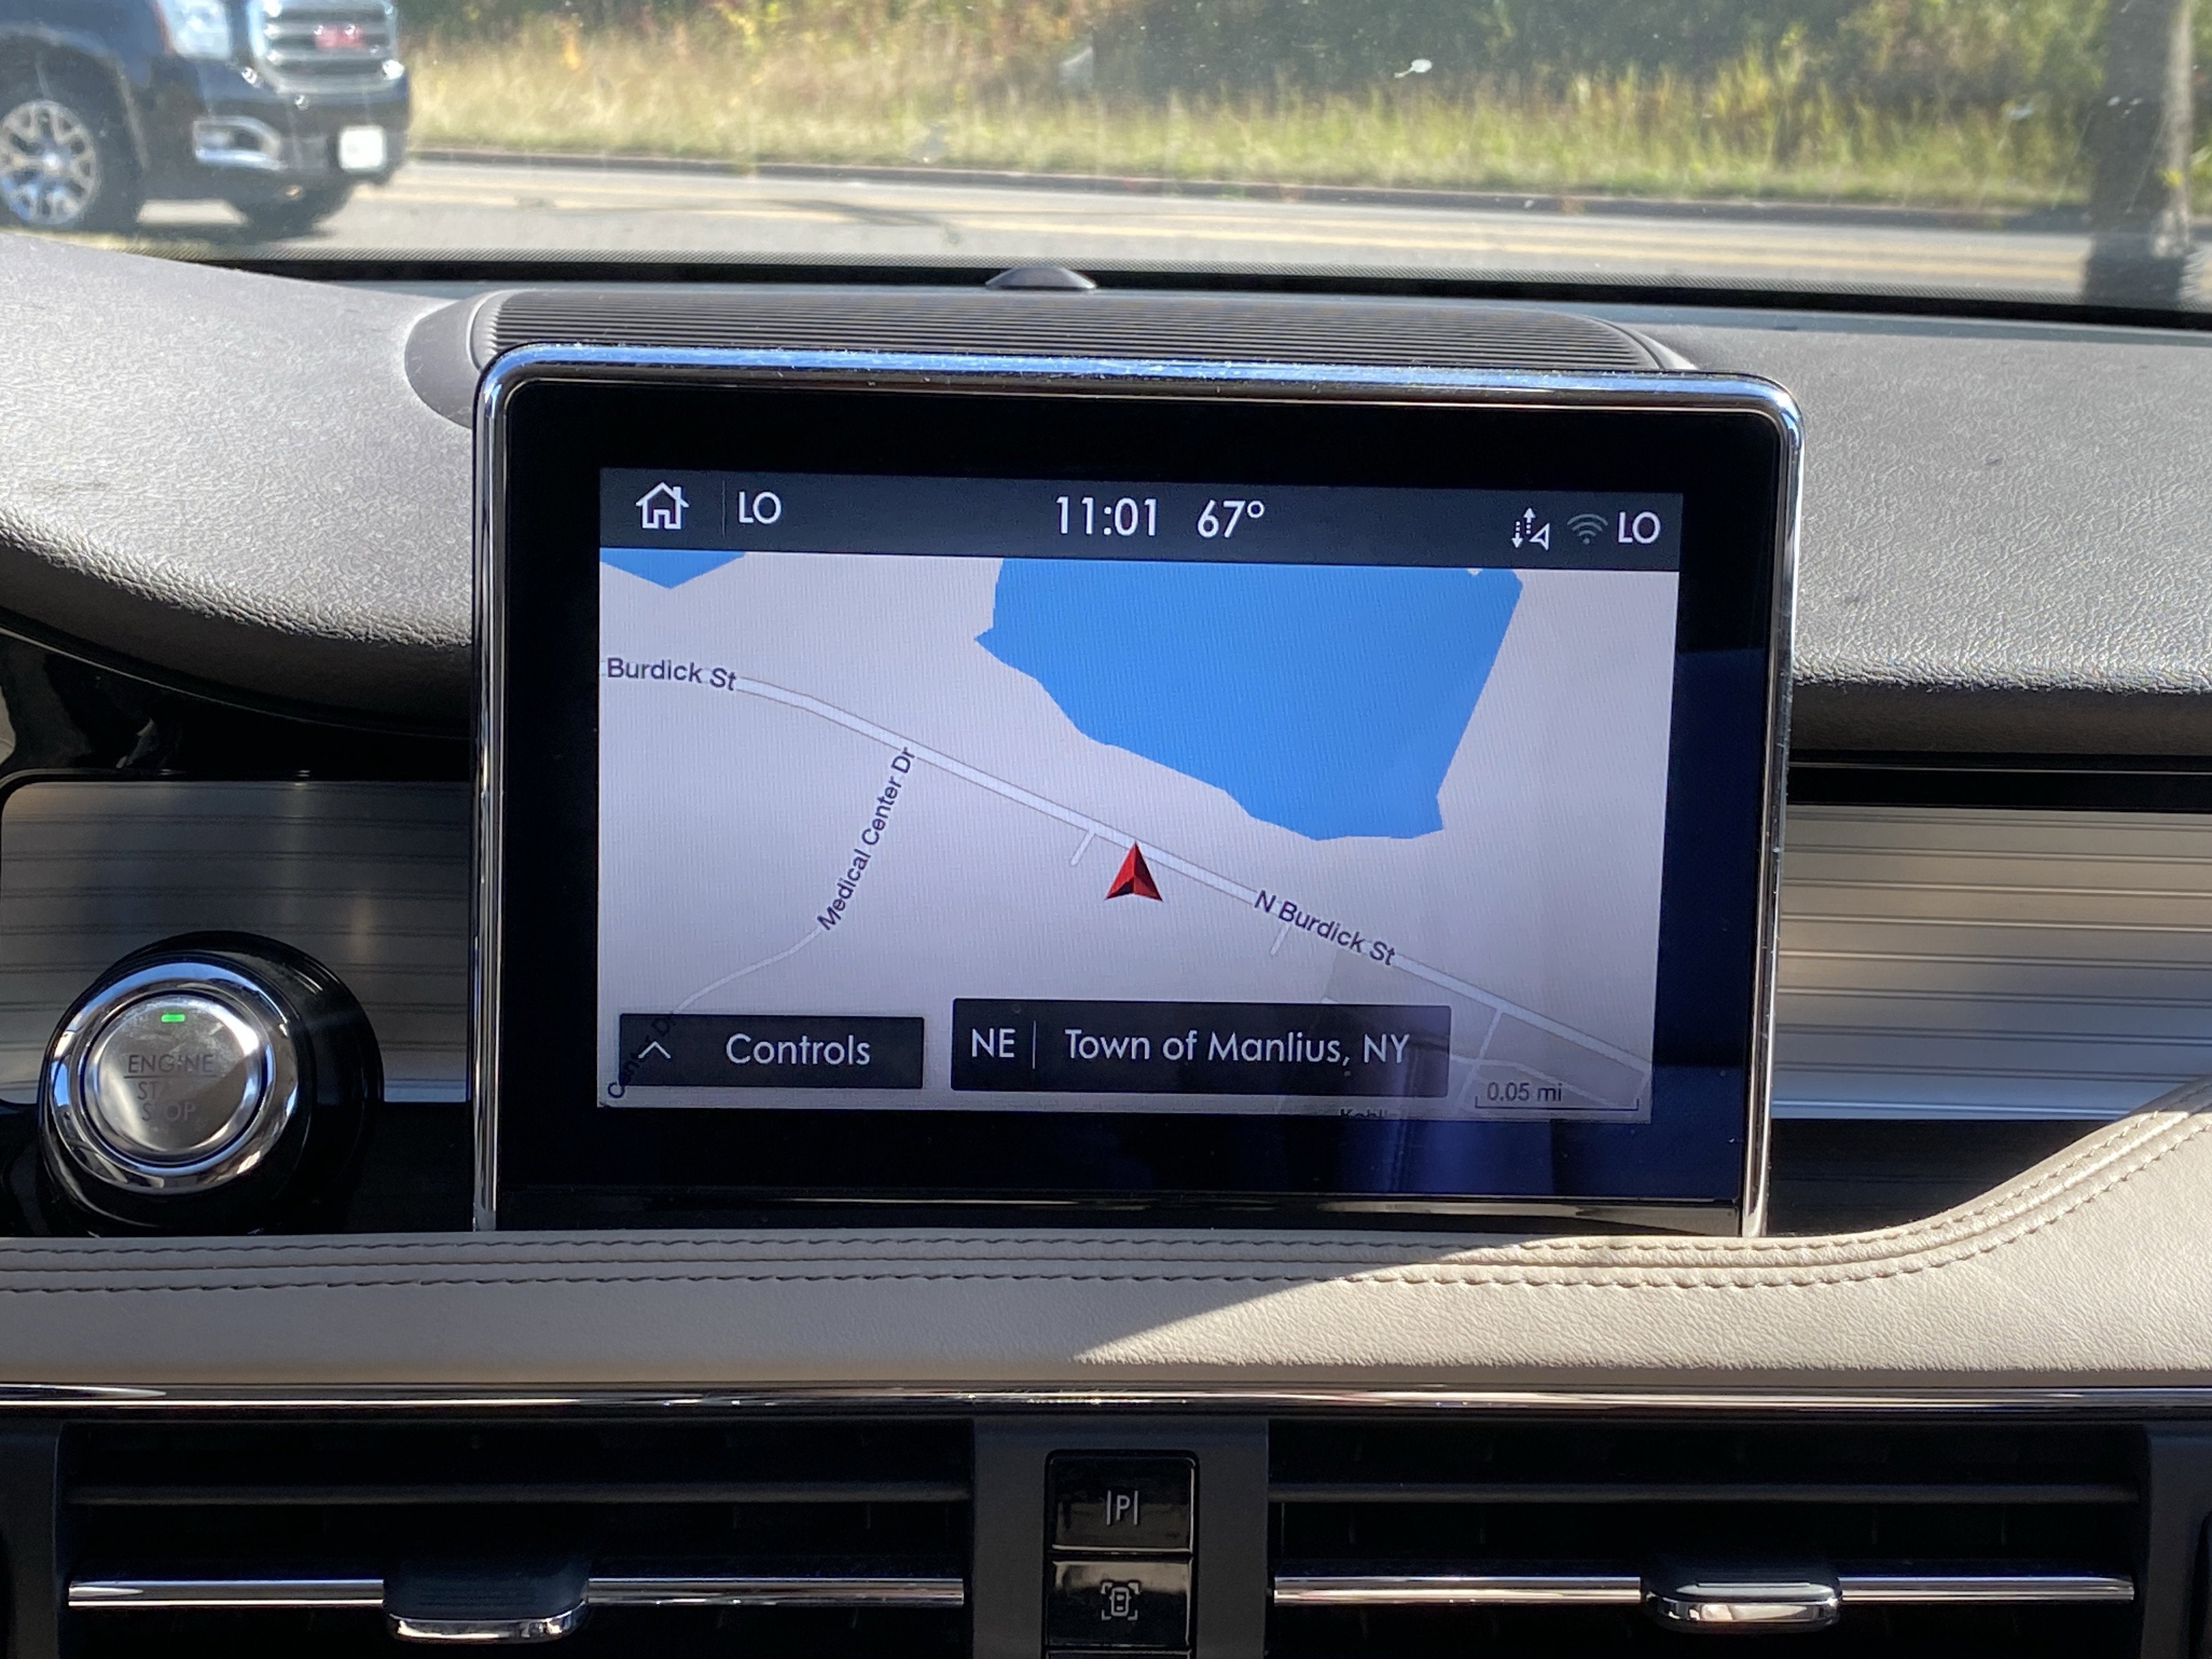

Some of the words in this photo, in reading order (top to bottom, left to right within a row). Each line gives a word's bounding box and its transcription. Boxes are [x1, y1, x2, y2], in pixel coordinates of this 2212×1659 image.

[738, 492, 782, 524] LO
[1057, 496, 1158, 537] 11:01
[1618, 511, 1661, 544] LO
[607, 658, 703, 684] Burdick
[709, 668, 737, 691] St
[817, 848, 872, 931] Medical
[862, 776, 904, 846] Center
[891, 746, 916, 774] Dr
[1254, 890, 1277, 913] N
[1278, 900, 1366, 953] Burdick
[1369, 940, 1396, 966] St
[726, 1033, 872, 1066] Controls
[970, 1029, 1016, 1058] NE
[1064, 1028, 1151, 1060] Town
[1163, 1029, 1197, 1060] of
[1207, 1032, 1351, 1066] Manlius,
[1362, 1034, 1410, 1064] NY
[128, 1054, 215, 1073] ENGINE
[1487, 1082, 1530, 1102] 0.05
[1537, 1082, 1563, 1102] mi
